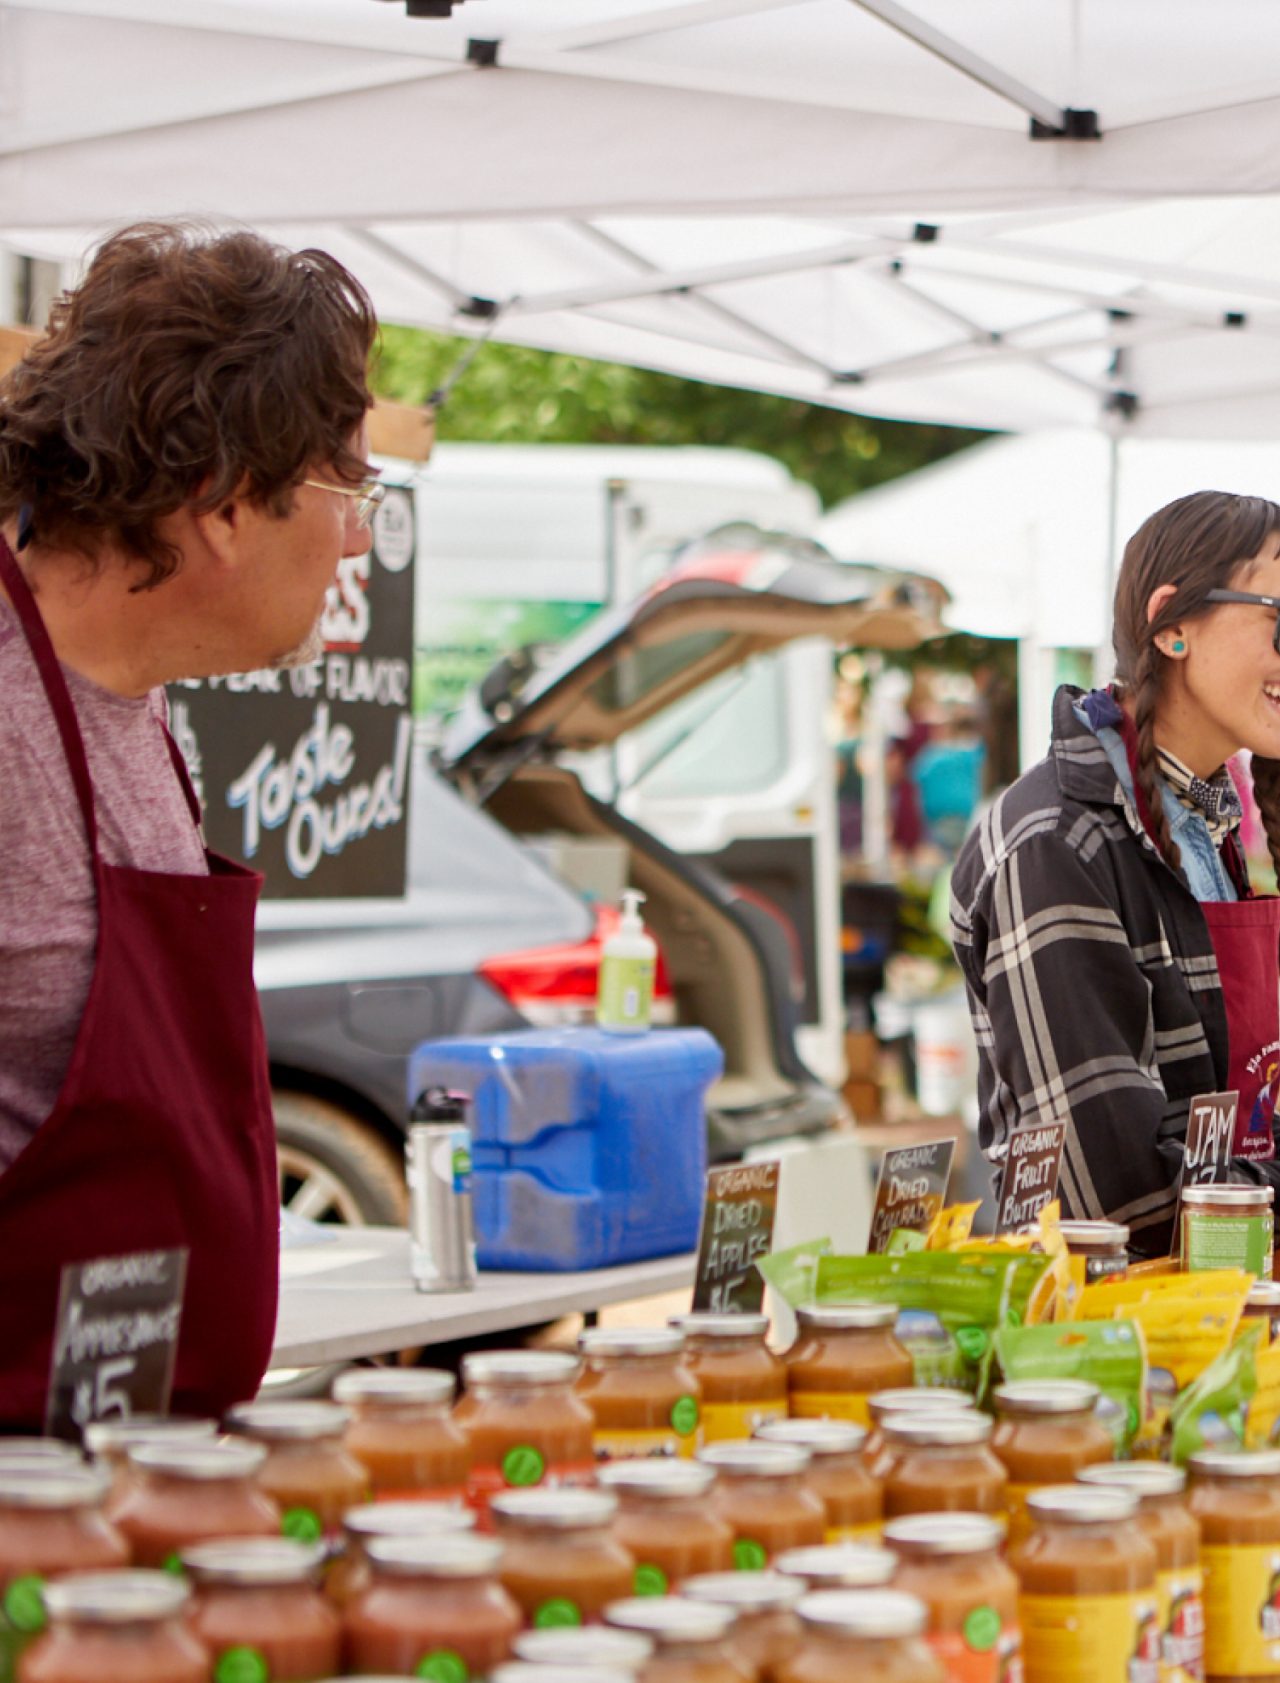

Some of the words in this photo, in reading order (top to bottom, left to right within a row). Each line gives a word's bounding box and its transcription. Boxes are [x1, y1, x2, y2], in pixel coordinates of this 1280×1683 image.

[228, 702, 356, 858] Taste
[286, 712, 411, 878] Ours!
[1011, 1128, 1060, 1158] ORGANIC
[1184, 1104, 1236, 1169] JAM
[715, 1164, 775, 1198] ORGANIC
[886, 1177, 929, 1207] DRIED
[1012, 1156, 1056, 1195] FRUIT
